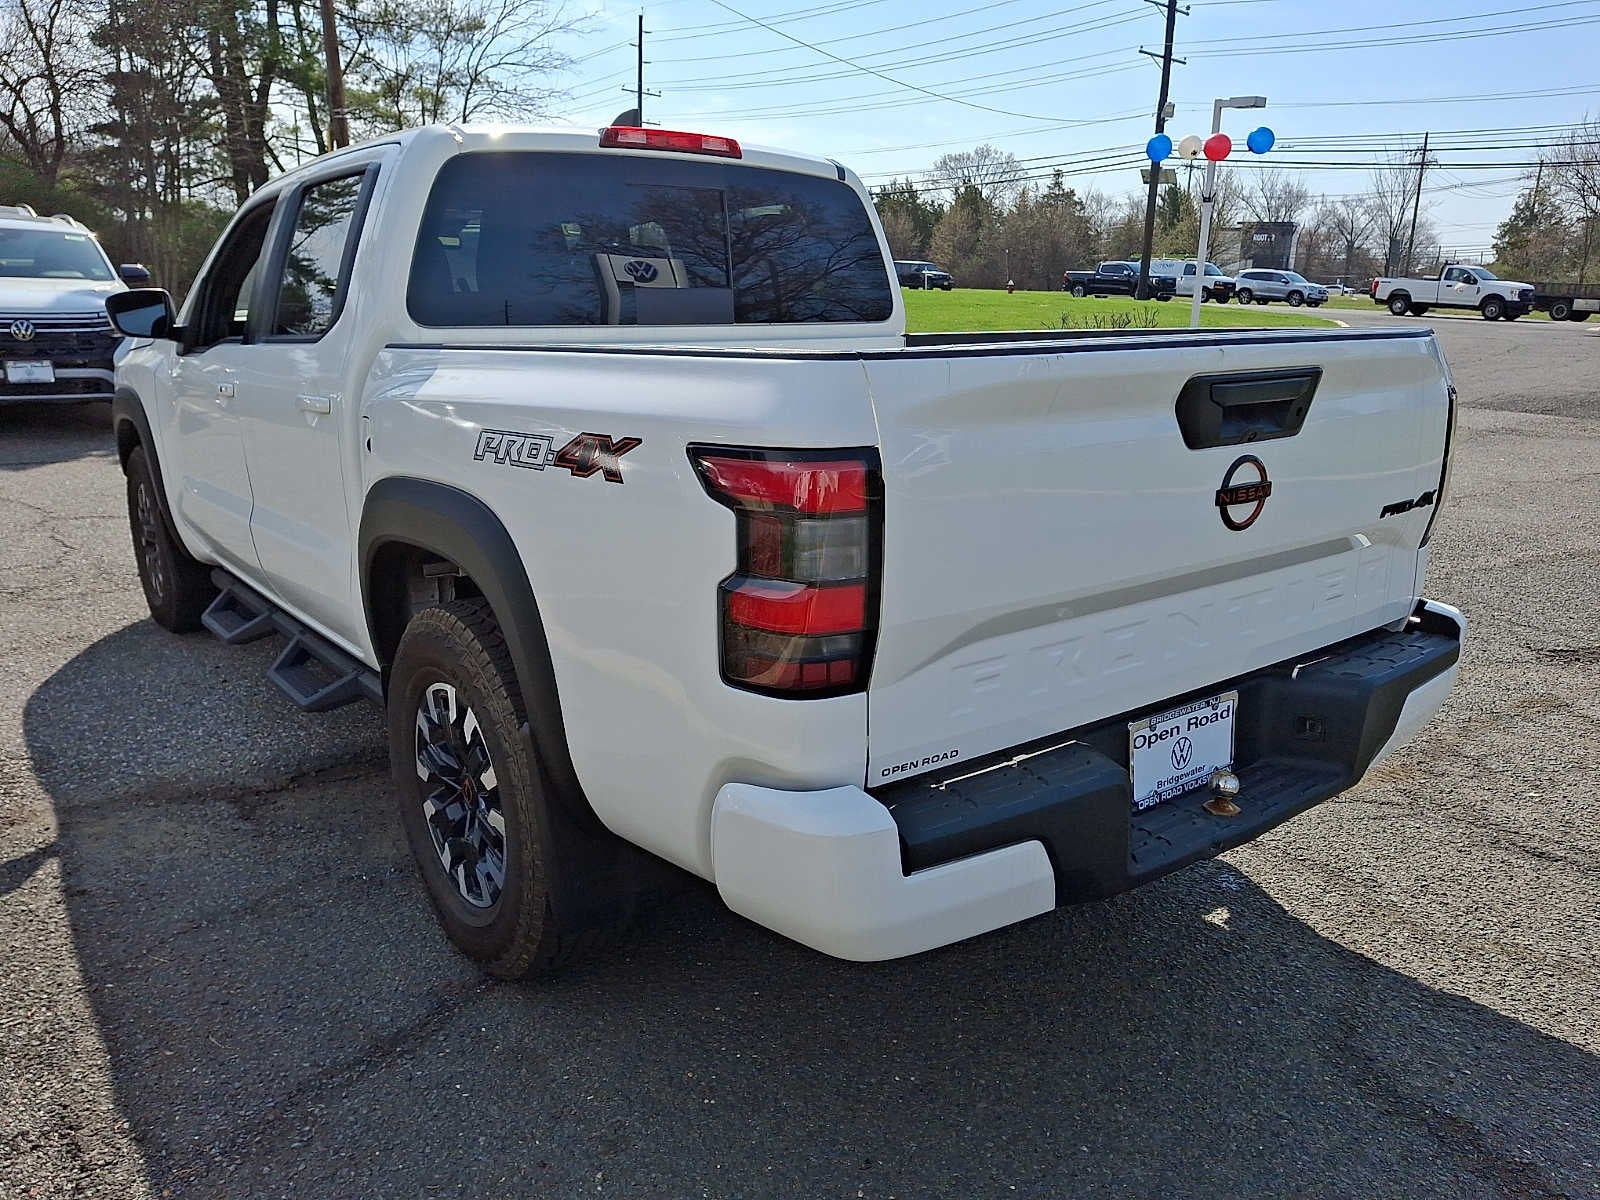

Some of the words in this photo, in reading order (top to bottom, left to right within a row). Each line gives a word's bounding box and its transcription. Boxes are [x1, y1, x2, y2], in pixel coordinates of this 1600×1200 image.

[1219, 484, 1271, 504] NISSAN
[1133, 725, 1180, 749] Open
[1187, 705, 1230, 732] Road
[881, 760, 919, 777] OPEN
[921, 749, 959, 766] ROAD
[1156, 765, 1206, 789] Bridgewater
[1138, 795, 1160, 810] OPEN
[1161, 786, 1183, 801] ROAD
